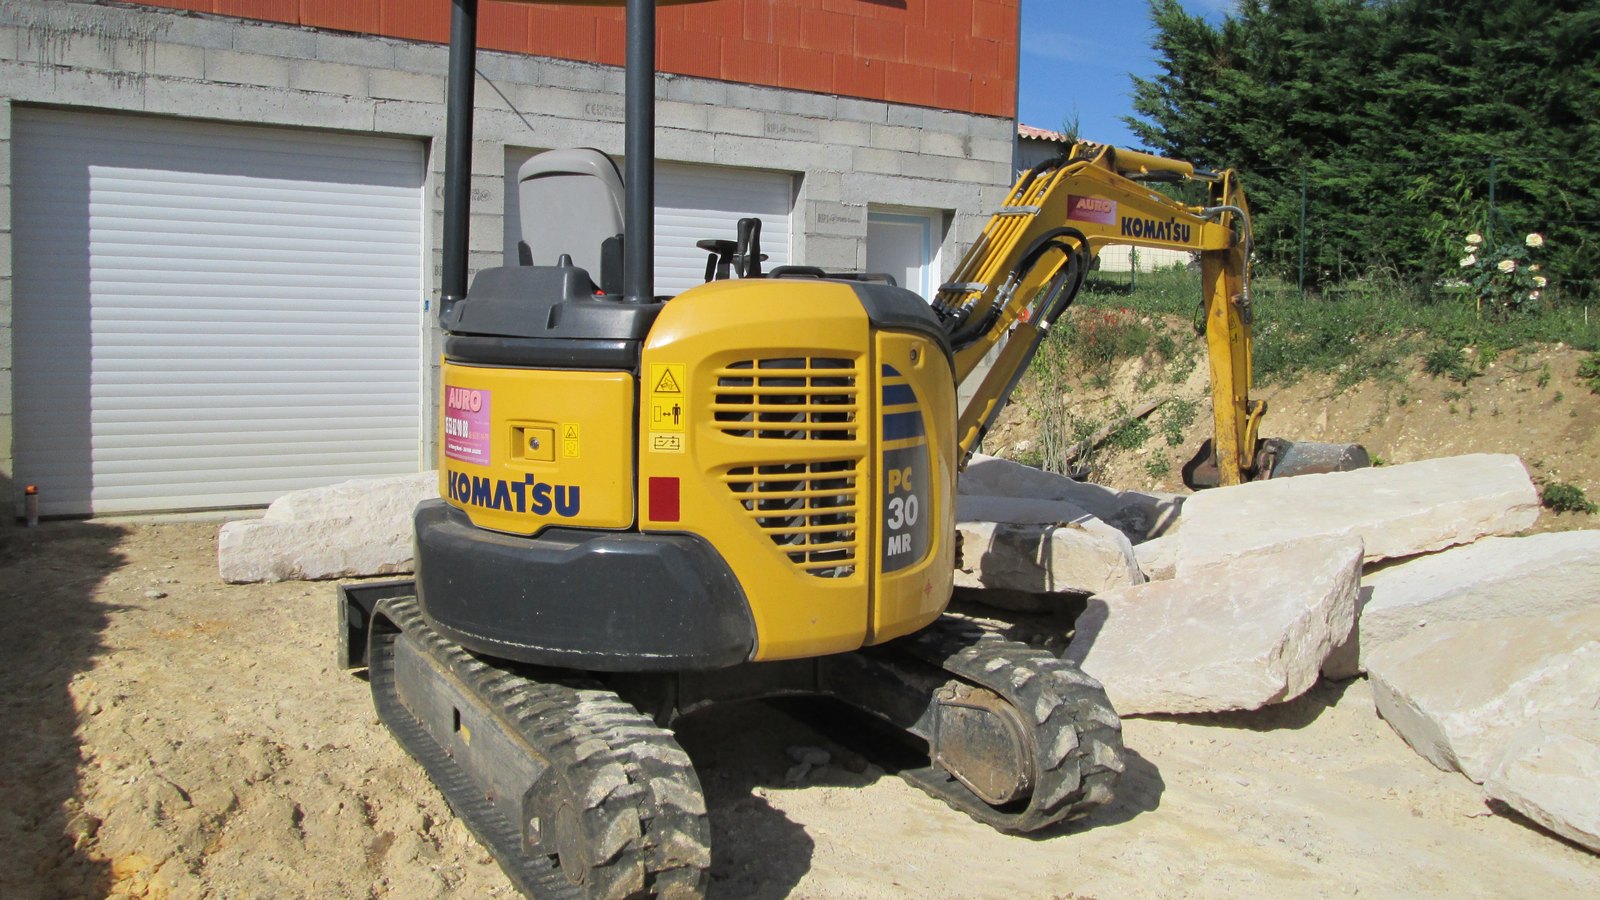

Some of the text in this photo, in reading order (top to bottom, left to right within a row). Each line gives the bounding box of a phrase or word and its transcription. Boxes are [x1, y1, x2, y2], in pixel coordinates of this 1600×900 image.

[1076, 198, 1112, 213] AURO
[1121, 216, 1190, 242] KOMATSU
[449, 387, 482, 412] AURO
[447, 469, 580, 517] KOMATSU
[888, 466, 912, 494] PC
[887, 494, 918, 530] 30
[887, 533, 911, 556] MR
